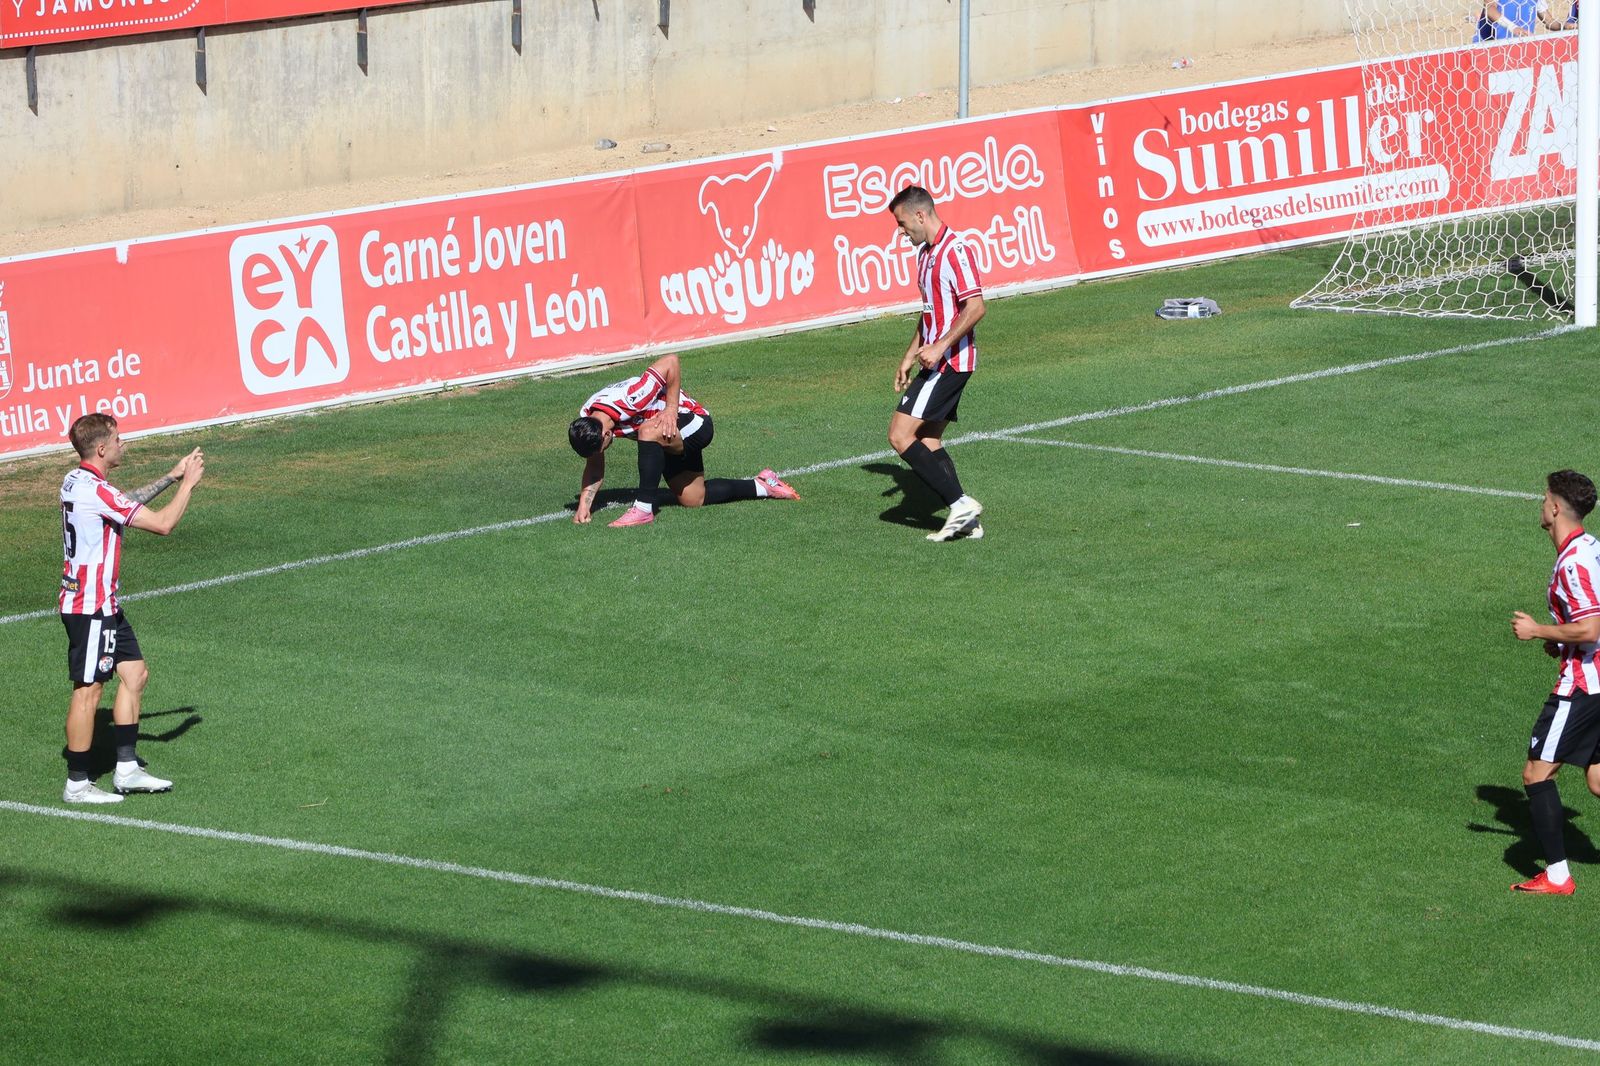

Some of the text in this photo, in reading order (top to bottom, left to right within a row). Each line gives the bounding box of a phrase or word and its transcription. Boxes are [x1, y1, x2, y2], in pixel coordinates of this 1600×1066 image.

[1179, 75, 1406, 136] bodegas del
[823, 136, 1044, 219] Escuela
[1133, 95, 1435, 201] Sumiller
[1143, 177, 1439, 240] www.bodegasdelsumiller.com
[359, 215, 566, 288] Carné Joven
[833, 205, 1056, 296] infntil
[366, 273, 610, 363] Castilla y León
[22, 348, 141, 393] Junta de
[56, 403, 72, 436] y
[102, 629, 117, 654] 15
